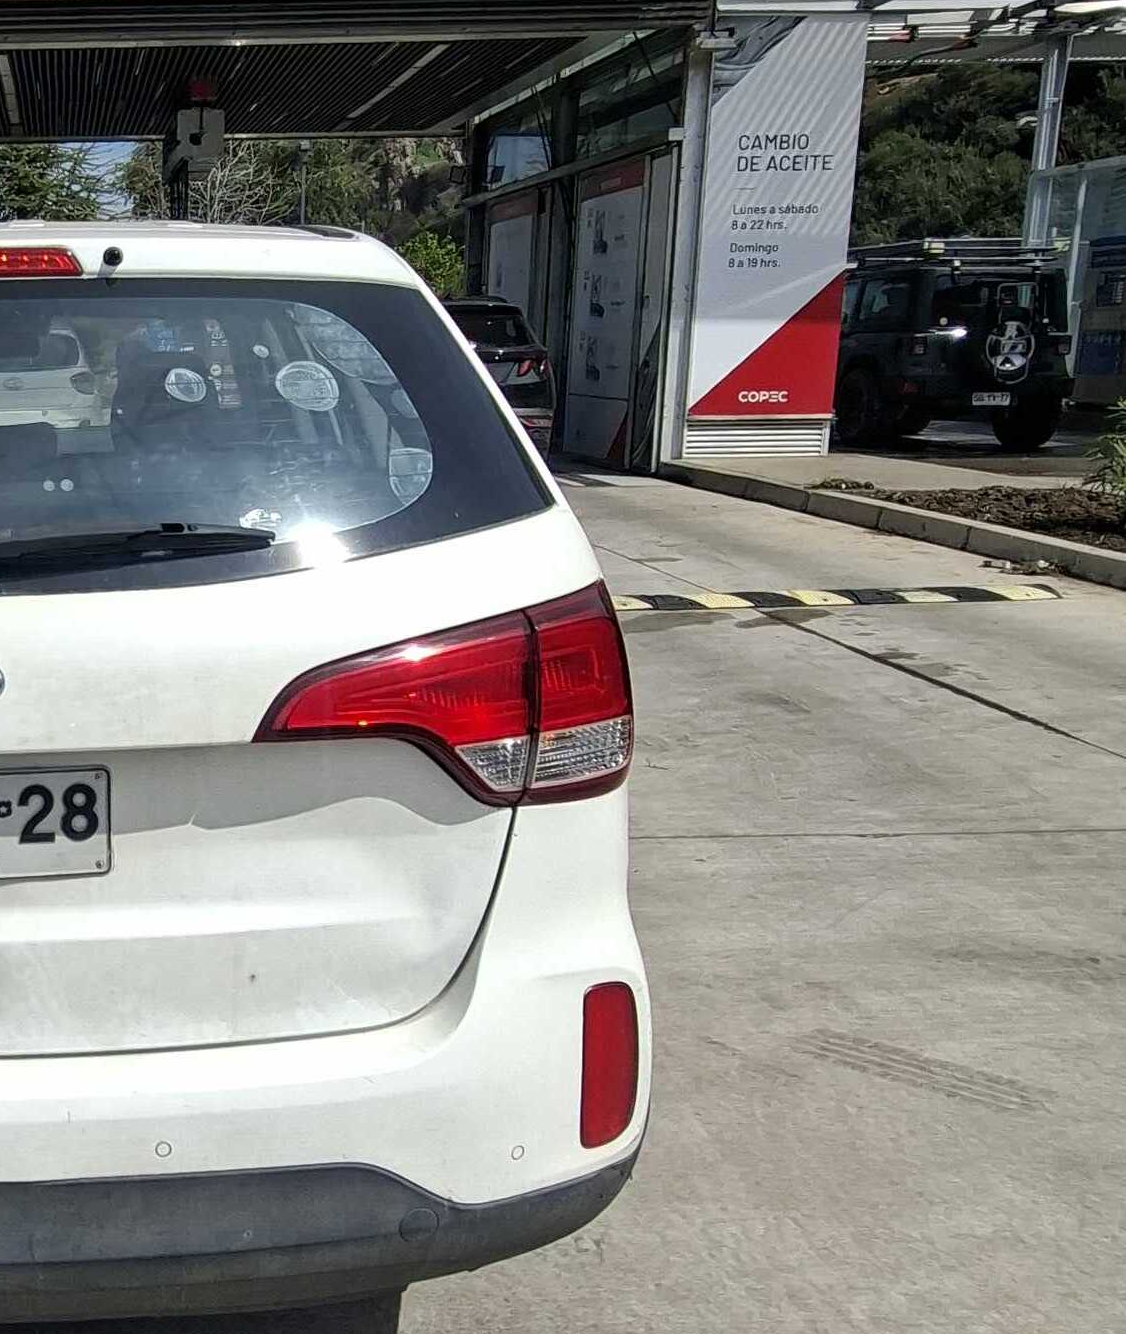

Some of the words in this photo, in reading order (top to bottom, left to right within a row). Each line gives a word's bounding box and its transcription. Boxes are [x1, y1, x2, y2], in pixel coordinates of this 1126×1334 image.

[738, 133, 810, 150] CAMBIO
[737, 155, 761, 172] DE
[766, 154, 835, 171] ACEITE
[732, 204, 767, 215] Lunes
[778, 204, 819, 214] sábado
[731, 220, 738, 230] 8
[750, 219, 764, 229] 22
[730, 242, 779, 254] Domingo
[728, 258, 735, 267] 8
[747, 257, 758, 267] 19
[760, 258, 781, 267] hrs.
[738, 391, 788, 403] COPEC
